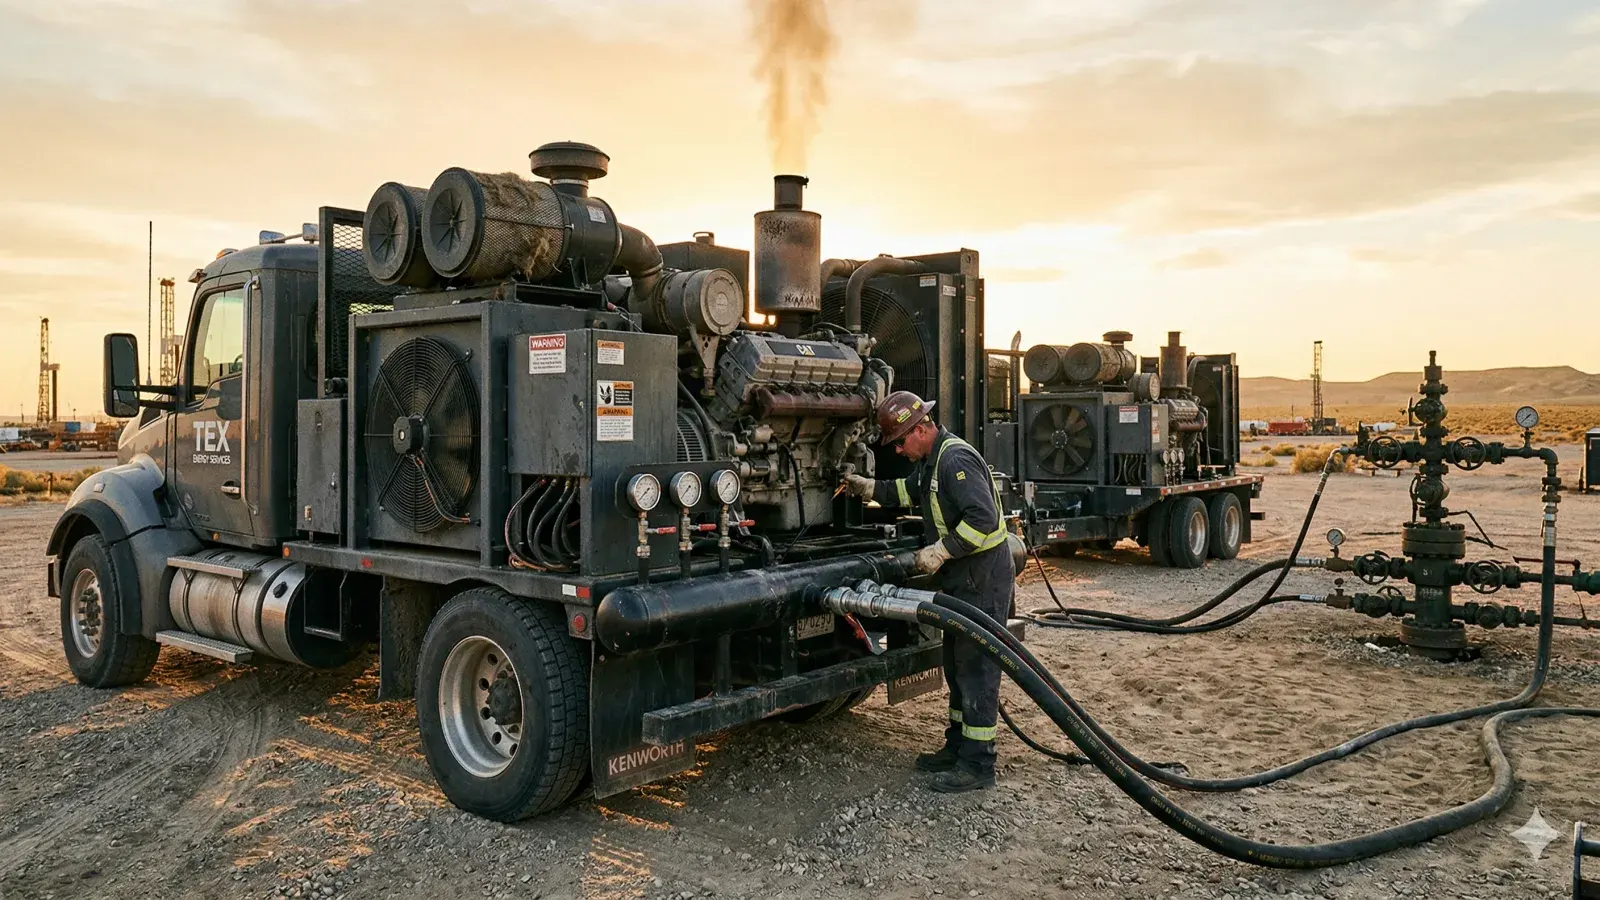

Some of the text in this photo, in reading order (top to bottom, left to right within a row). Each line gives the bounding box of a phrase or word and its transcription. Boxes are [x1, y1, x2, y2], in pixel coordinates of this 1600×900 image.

[796, 344, 815, 355] CAT
[193, 420, 230, 452] TEX
[609, 740, 684, 775] KENWORTH
